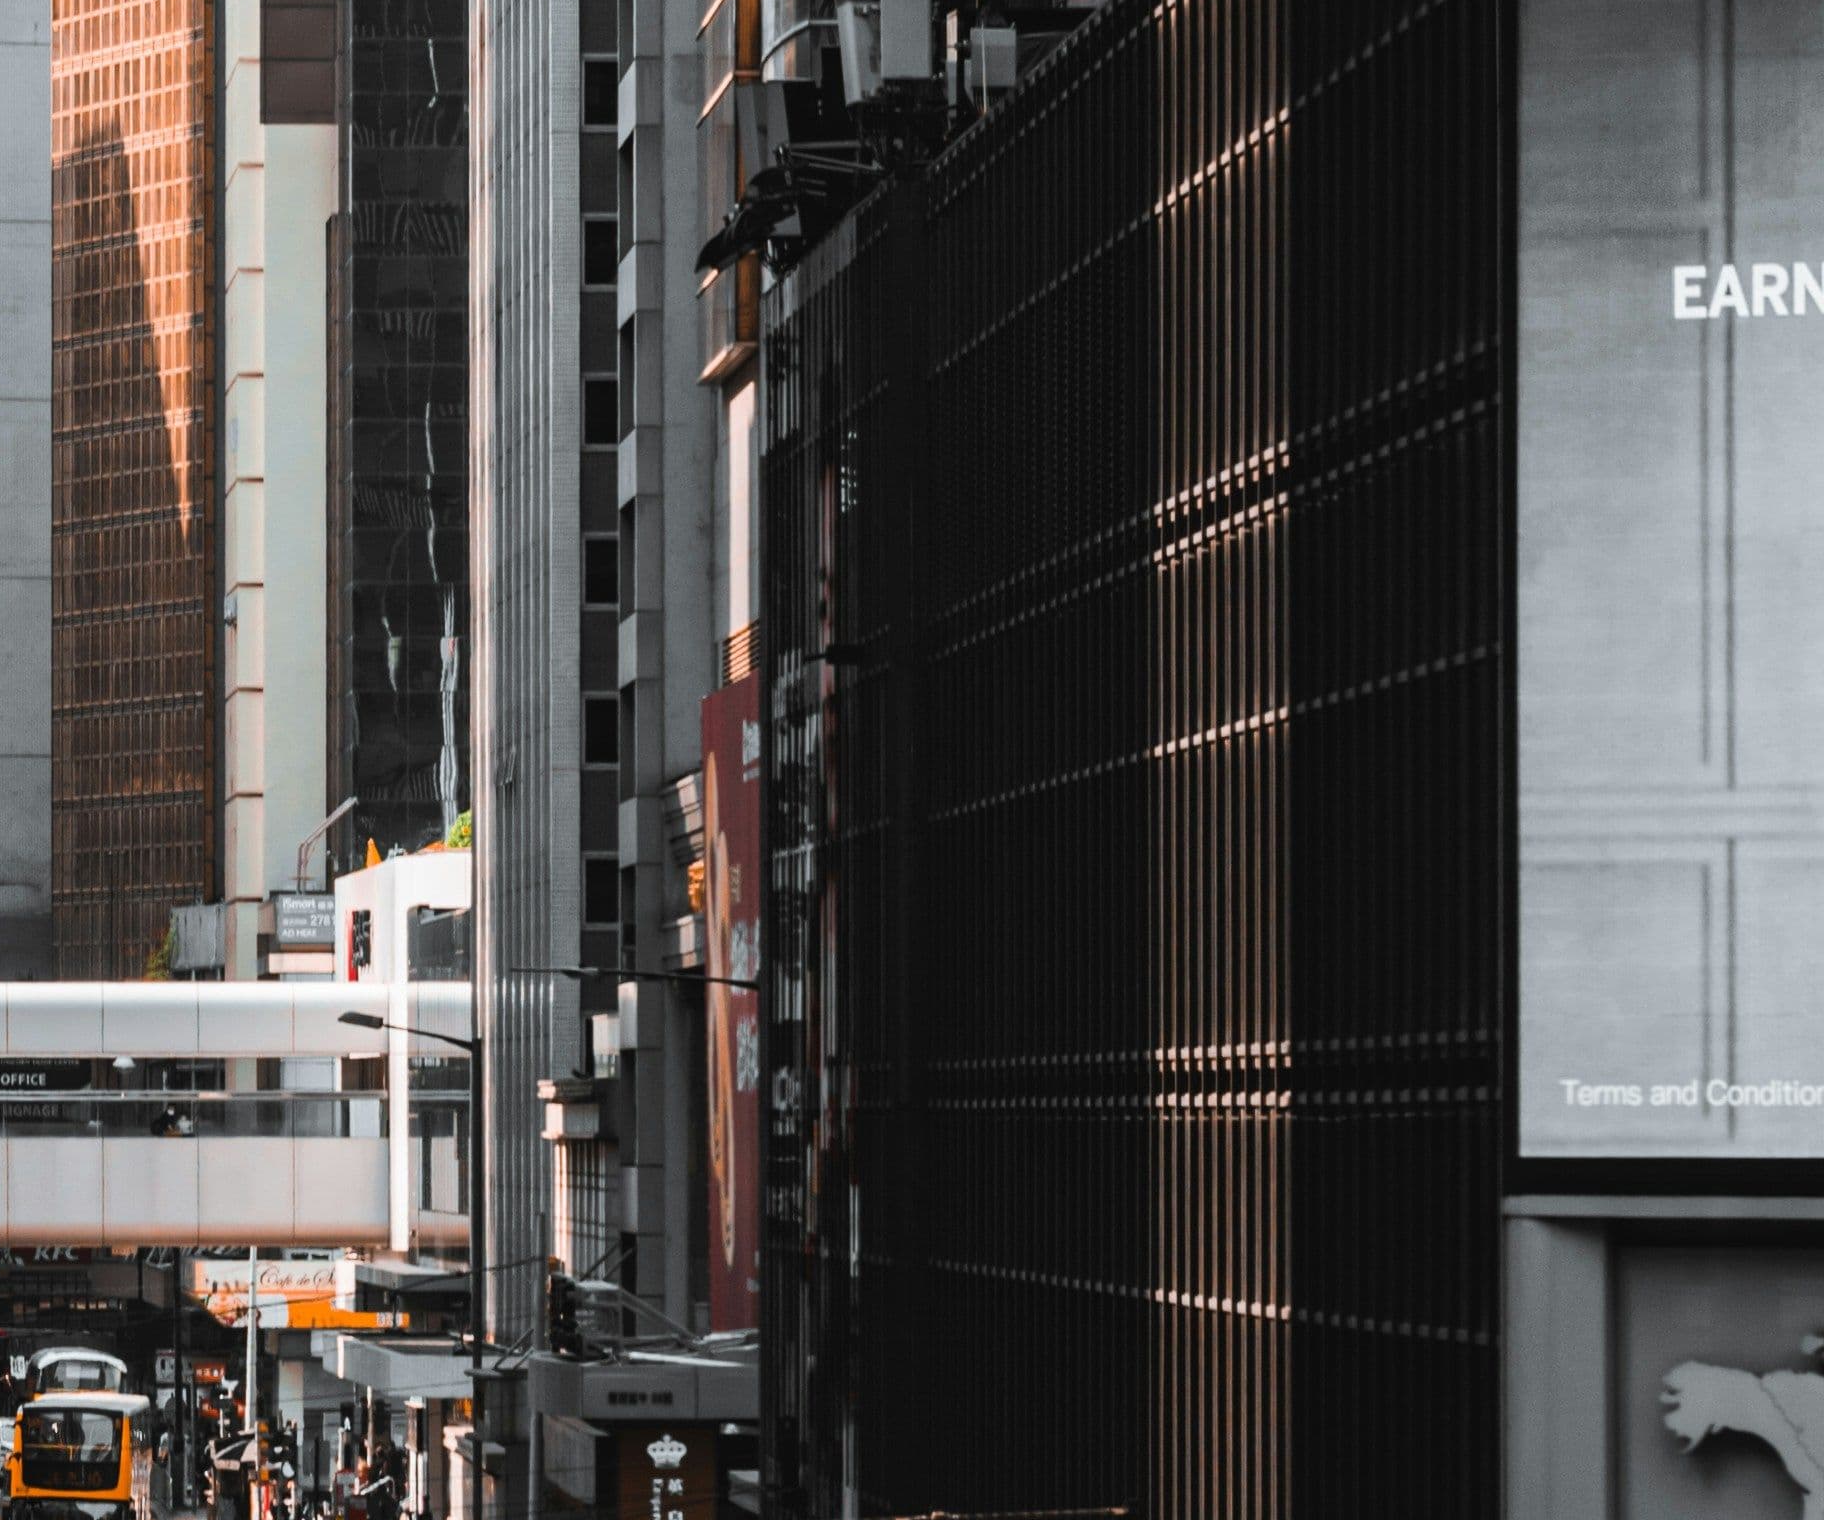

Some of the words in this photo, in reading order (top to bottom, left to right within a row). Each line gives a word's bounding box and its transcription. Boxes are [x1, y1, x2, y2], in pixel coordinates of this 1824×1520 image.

[1672, 262, 1824, 320] EARN
[0, 1072, 48, 1088] OFFICE
[1560, 1078, 1642, 1107] Terms
[1650, 1078, 1700, 1107] and
